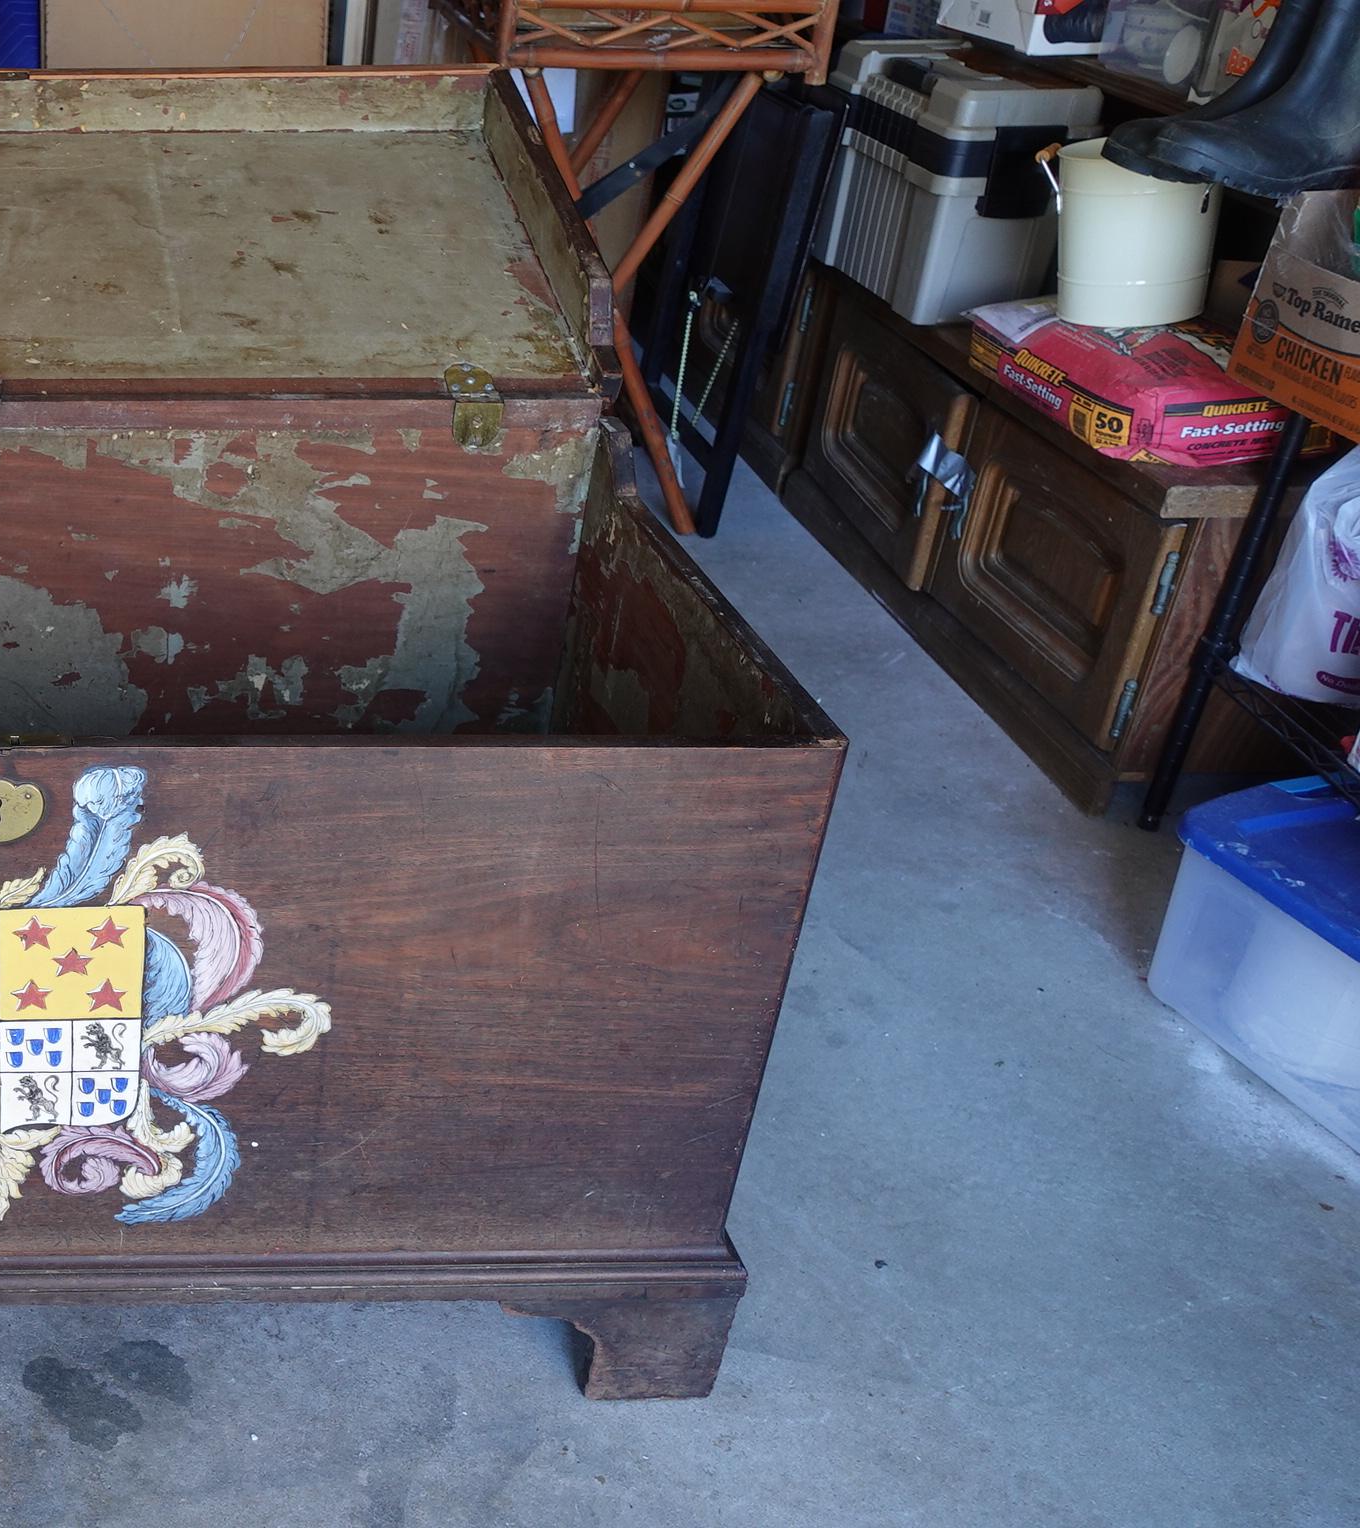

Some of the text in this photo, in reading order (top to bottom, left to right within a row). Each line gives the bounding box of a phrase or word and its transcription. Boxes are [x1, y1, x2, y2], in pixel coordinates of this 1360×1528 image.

[1286, 287, 1312, 318] Top
[1313, 299, 1360, 335] Rame
[1013, 348, 1067, 388] QUIKRETE
[1275, 336, 1345, 387] CHICKEN
[1003, 363, 1063, 410] Fast-Setting
[1095, 411, 1124, 434] 50
[1202, 400, 1270, 417] QUIKRETE
[1180, 419, 1286, 439] Fast-Setting
